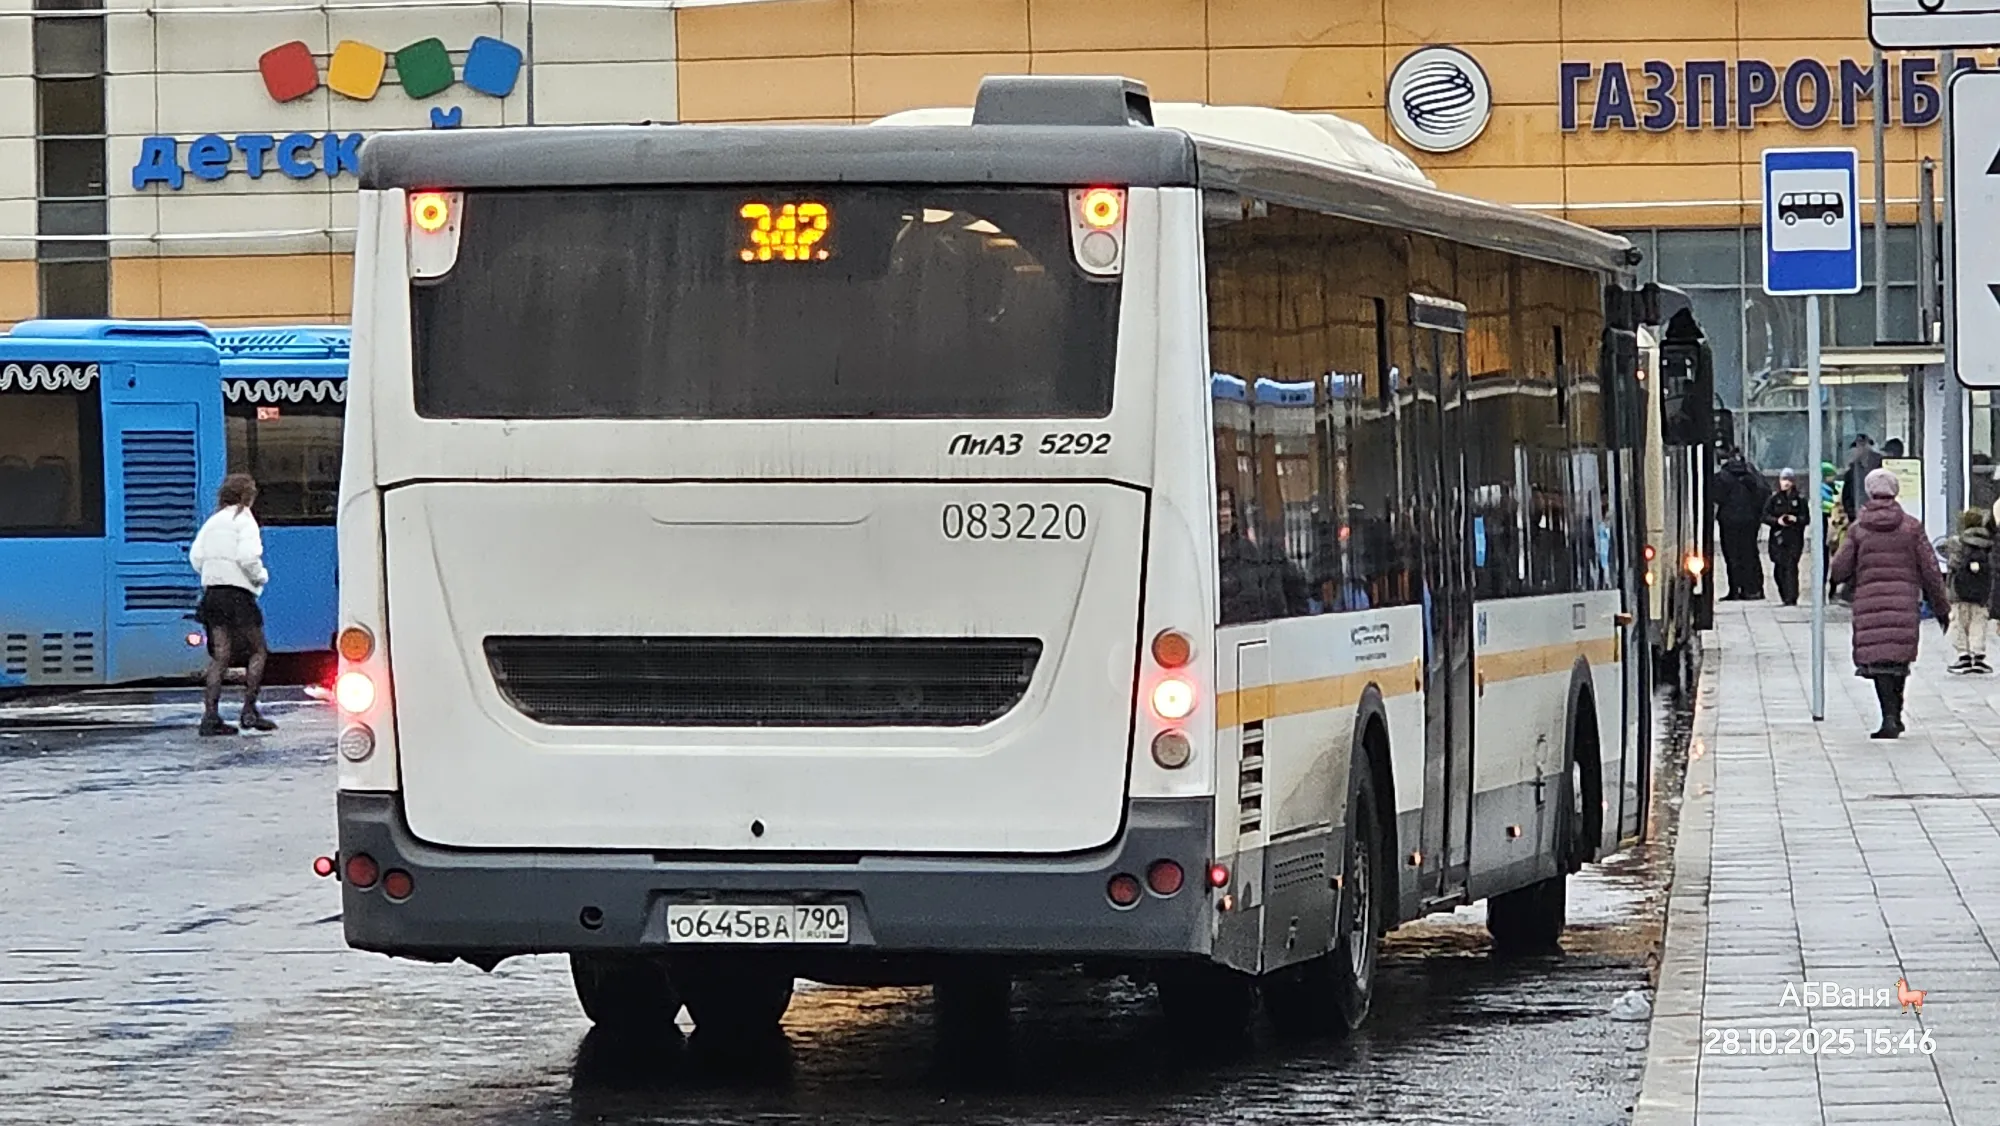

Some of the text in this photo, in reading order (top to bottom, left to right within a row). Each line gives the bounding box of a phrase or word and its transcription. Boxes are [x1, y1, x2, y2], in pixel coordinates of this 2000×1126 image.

[1559, 57, 2000, 132] ГАЗПРОМБ
[1038, 433, 1112, 454] 5292
[942, 503, 1087, 540] 083220
[676, 907, 840, 939] О645ВА 790
